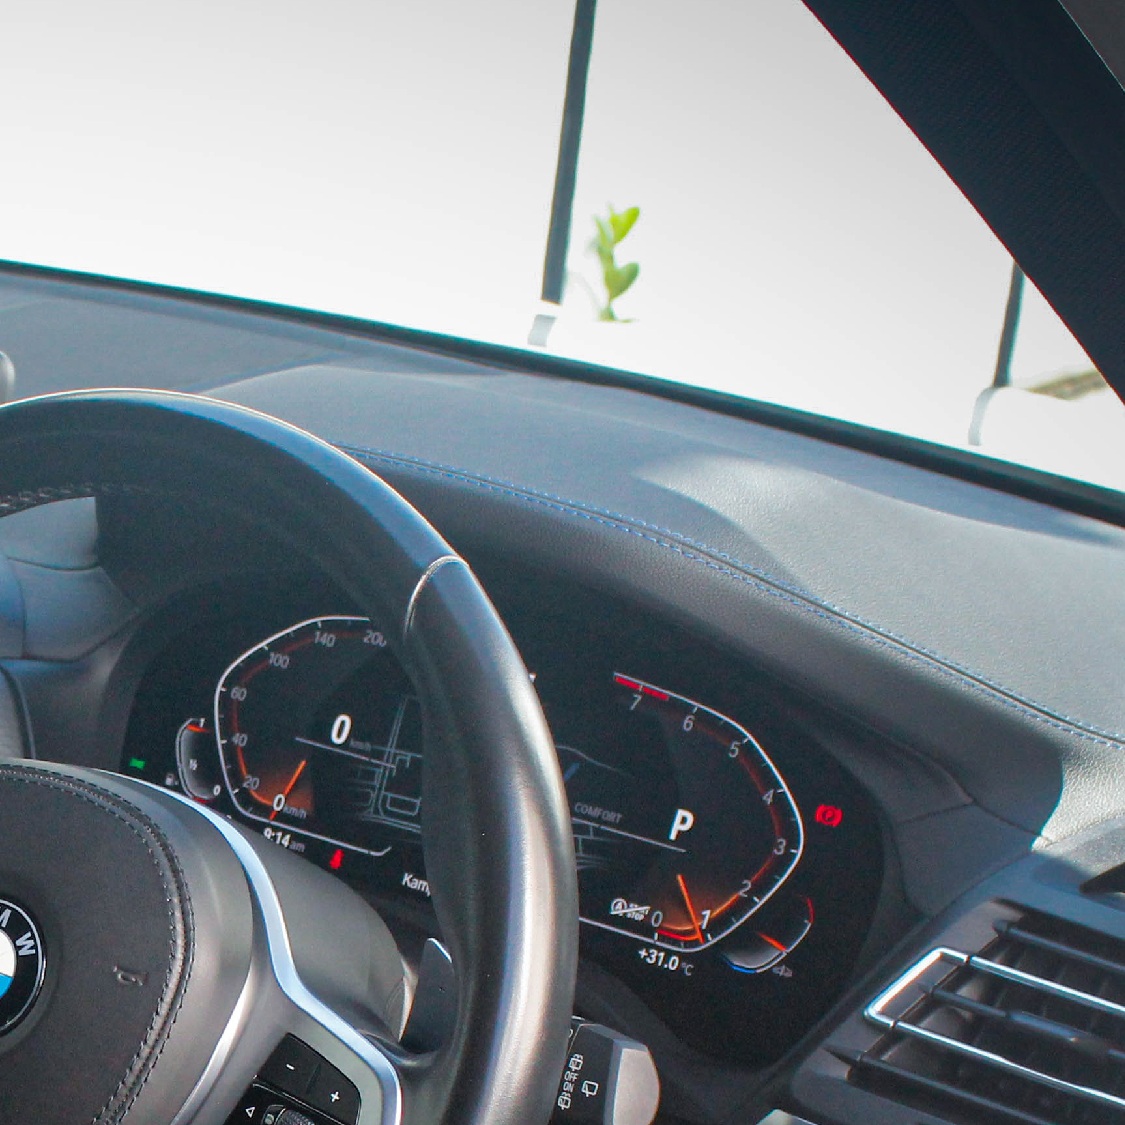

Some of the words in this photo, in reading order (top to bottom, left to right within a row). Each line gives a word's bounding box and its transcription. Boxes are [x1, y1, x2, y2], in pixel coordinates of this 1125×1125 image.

[314, 631, 336, 648] 140
[269, 652, 290, 669] 100
[230, 687, 247, 701] 60
[629, 694, 643, 711] 7
[331, 714, 352, 745] 0
[682, 715, 695, 732] 6
[231, 733, 248, 747] 40
[728, 742, 741, 758] 5
[213, 784, 221, 797] 0
[243, 775, 260, 791] 20
[762, 789, 775, 805] 4
[273, 794, 286, 811] 0
[283, 805, 307, 819] km/h
[574, 802, 623, 824] COMFORT
[669, 808, 695, 840] P
[774, 838, 787, 855] 3
[739, 880, 752, 897] 2
[651, 911, 663, 927] 0
[701, 910, 711, 929] 1
[638, 948, 680, 971] +31.0
[564, 1070, 579, 1082] OFF
[562, 1081, 575, 1093] ON
